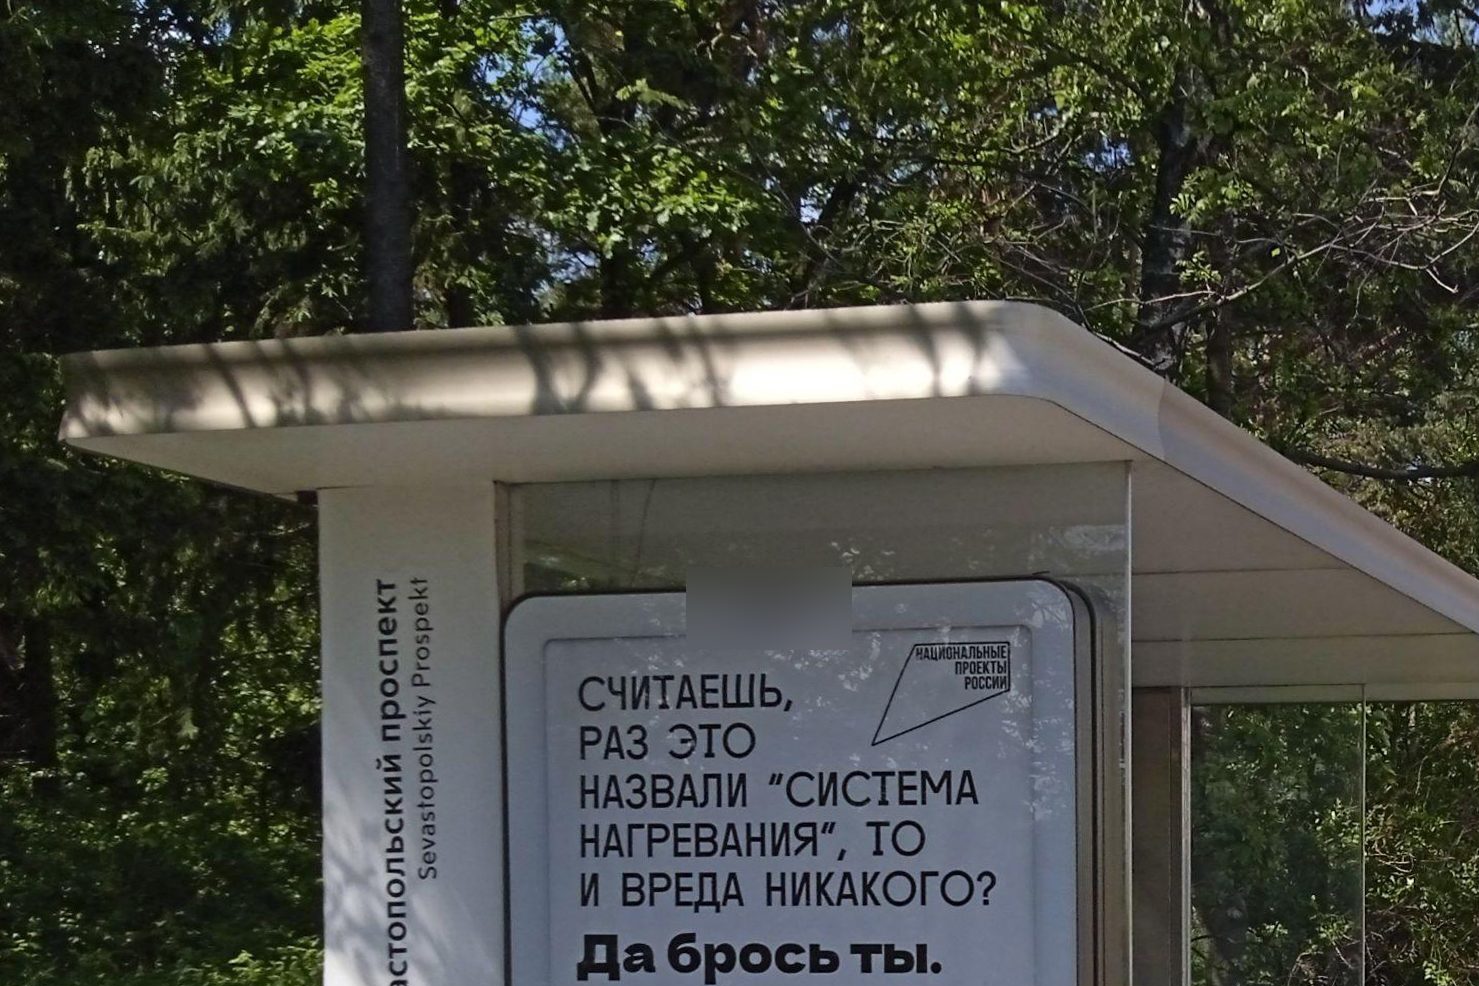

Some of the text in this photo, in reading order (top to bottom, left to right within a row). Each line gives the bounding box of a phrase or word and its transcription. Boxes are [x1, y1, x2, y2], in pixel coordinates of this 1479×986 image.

[376, 578, 407, 741] проспект
[915, 645, 1007, 661] НАЦИОНАЛЬНЫЕ
[955, 661, 1007, 674] ПРОЕКТЫ
[578, 673, 793, 712] СЧИТАЕШЬ,
[964, 676, 1007, 690] РОССИИ
[408, 577, 438, 880] Sevastopolskiy Prospekt
[579, 722, 757, 760] РАЗ ЭТО
[580, 773, 748, 809] НАЗВАЛИ
[866, 820, 926, 857] ТО
[580, 870, 997, 914] И ВРЕДА НИКАКОГО?
[577, 932, 943, 985] Да брось ты.
